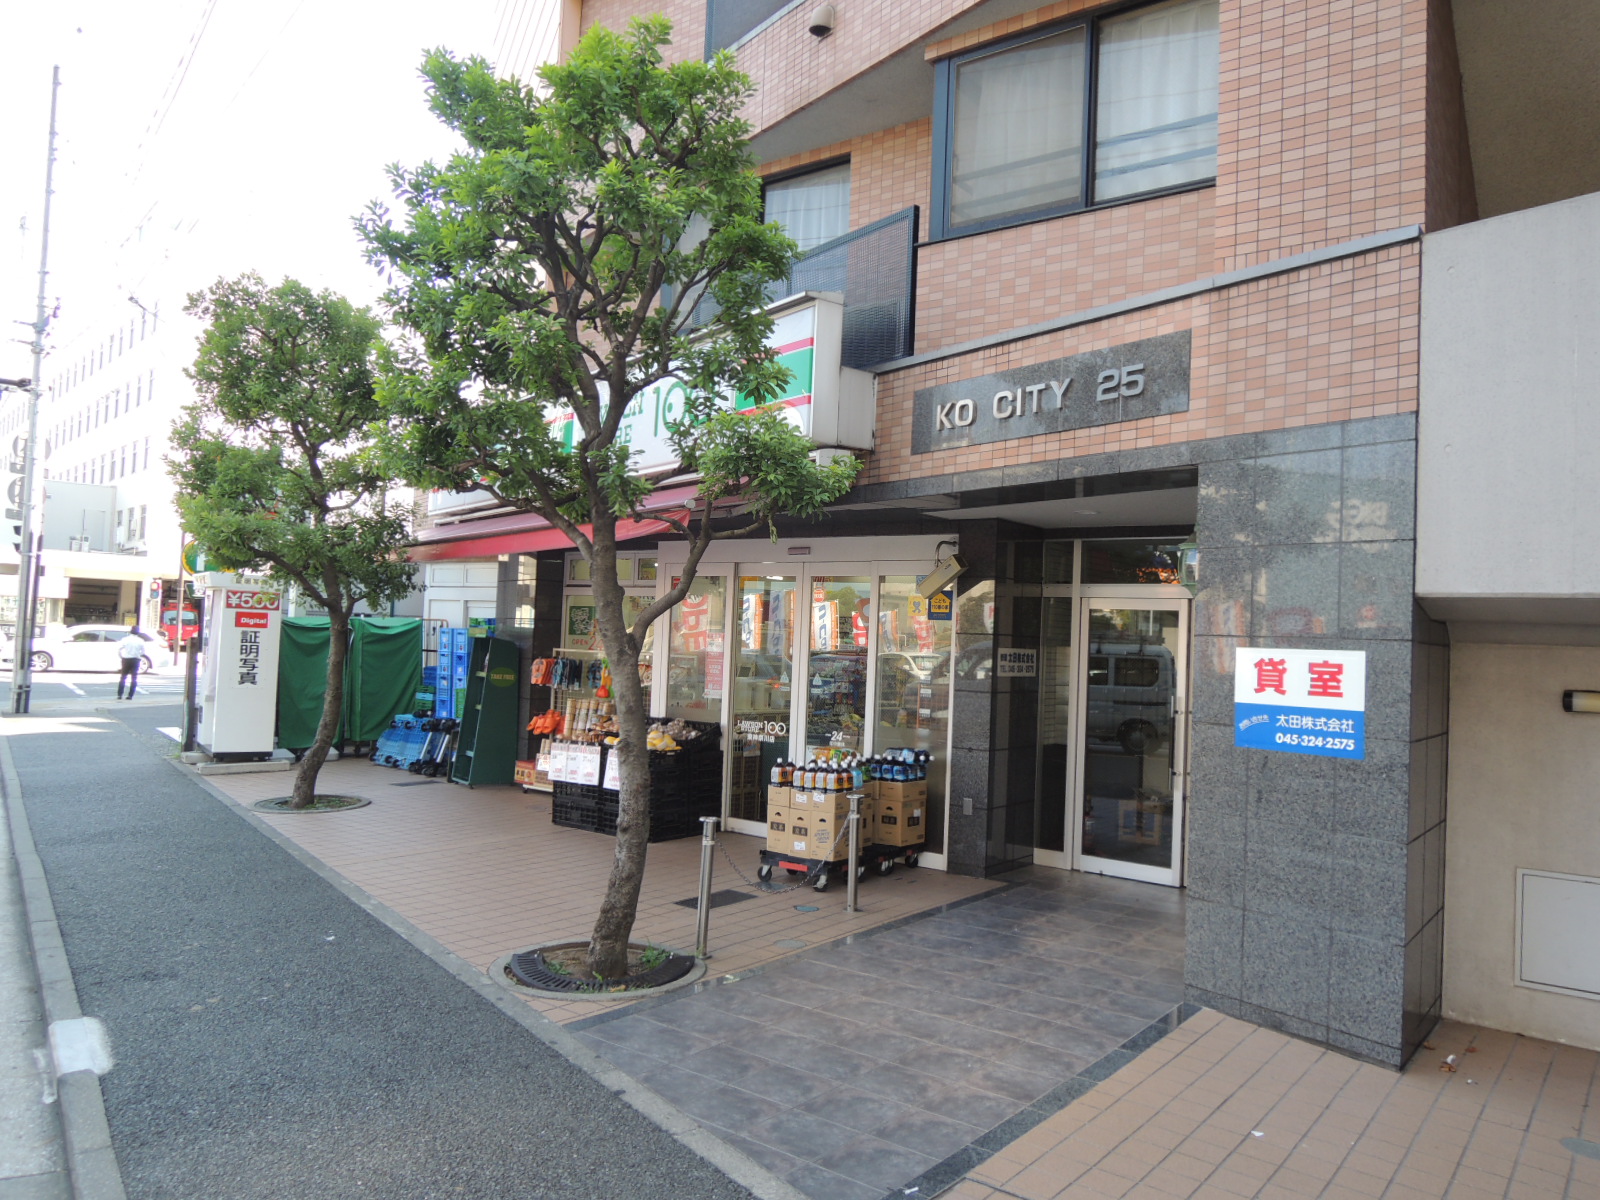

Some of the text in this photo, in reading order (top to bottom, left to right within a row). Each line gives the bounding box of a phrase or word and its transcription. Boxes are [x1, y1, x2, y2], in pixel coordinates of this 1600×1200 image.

[937, 363, 1144, 431] KO CITY 25
[227, 591, 279, 609] ¥500
[241, 617, 267, 625] Digital
[572, 638, 588, 646] OPEN
[238, 630, 261, 685] 証明写真
[1254, 658, 1344, 697] 貸室
[737, 719, 786, 735] LAWSON 100
[1275, 714, 1355, 734] 太田株式会社
[831, 731, 843, 741] 24
